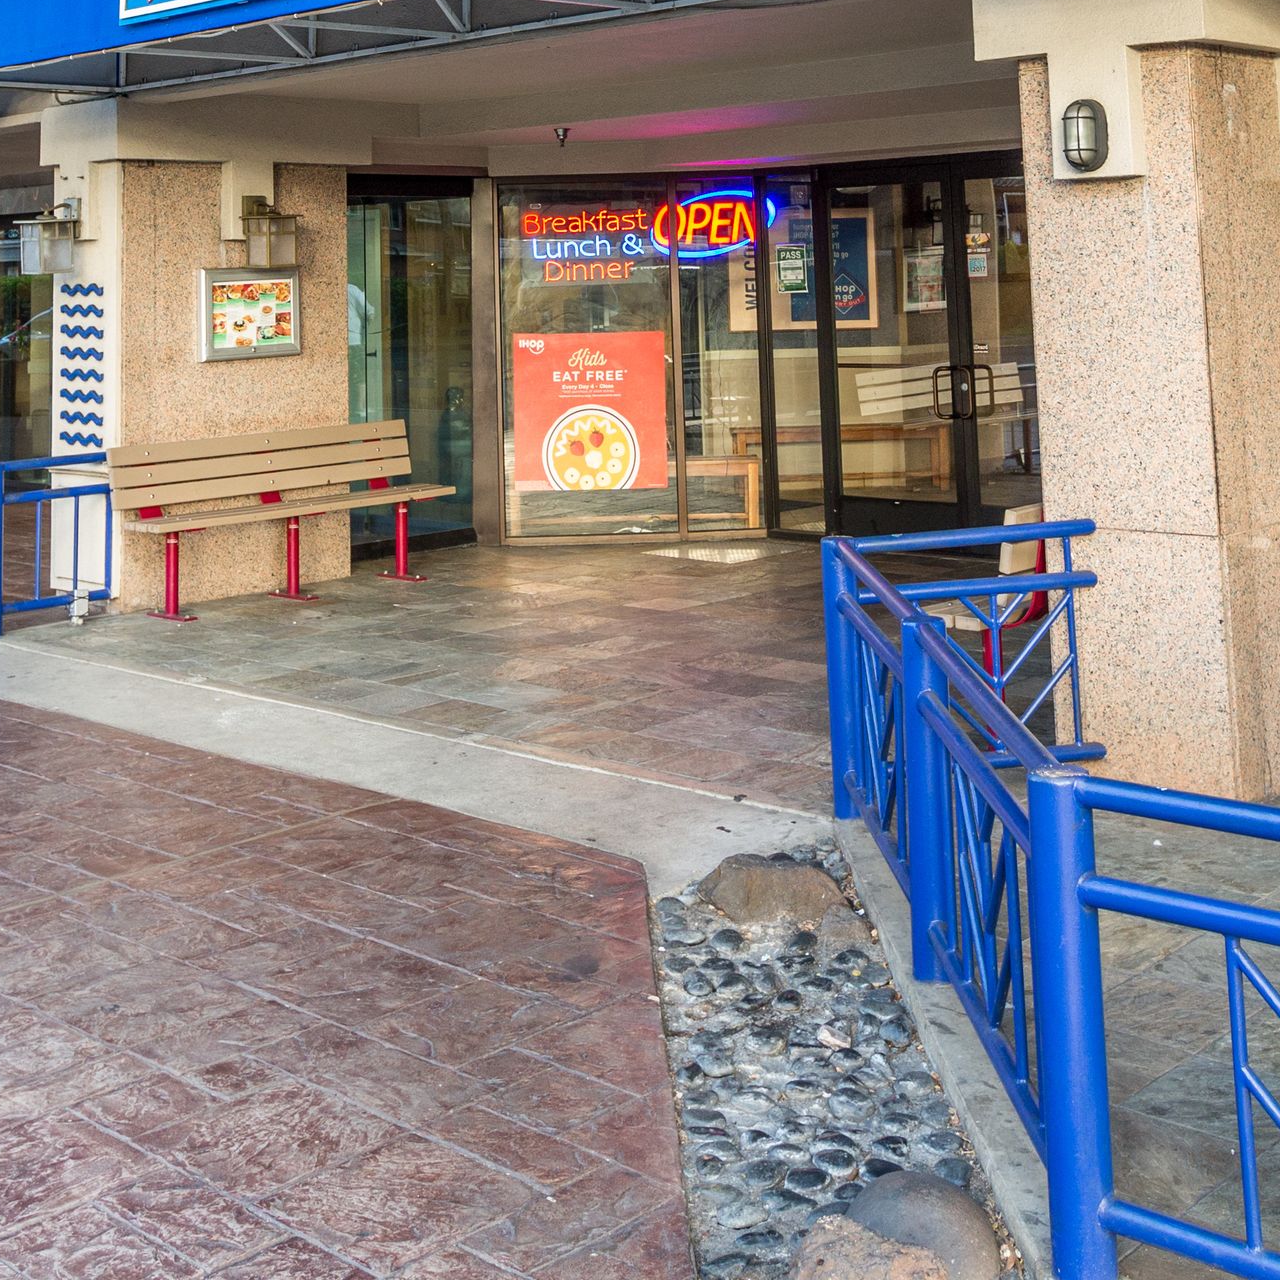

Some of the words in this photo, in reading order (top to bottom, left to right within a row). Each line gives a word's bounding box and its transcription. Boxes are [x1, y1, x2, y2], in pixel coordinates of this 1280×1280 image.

[523, 209, 648, 235] Breakfast
[653, 202, 755, 246] OPEN
[532, 235, 611, 260] Lunch
[622, 233, 645, 255] &
[780, 251, 801, 260] PASS
[545, 260, 635, 282] Dinner
[834, 285, 856, 294] HOP
[519, 339, 545, 351] IHOP
[568, 348, 607, 370] Kids
[552, 371, 579, 382] EAT
